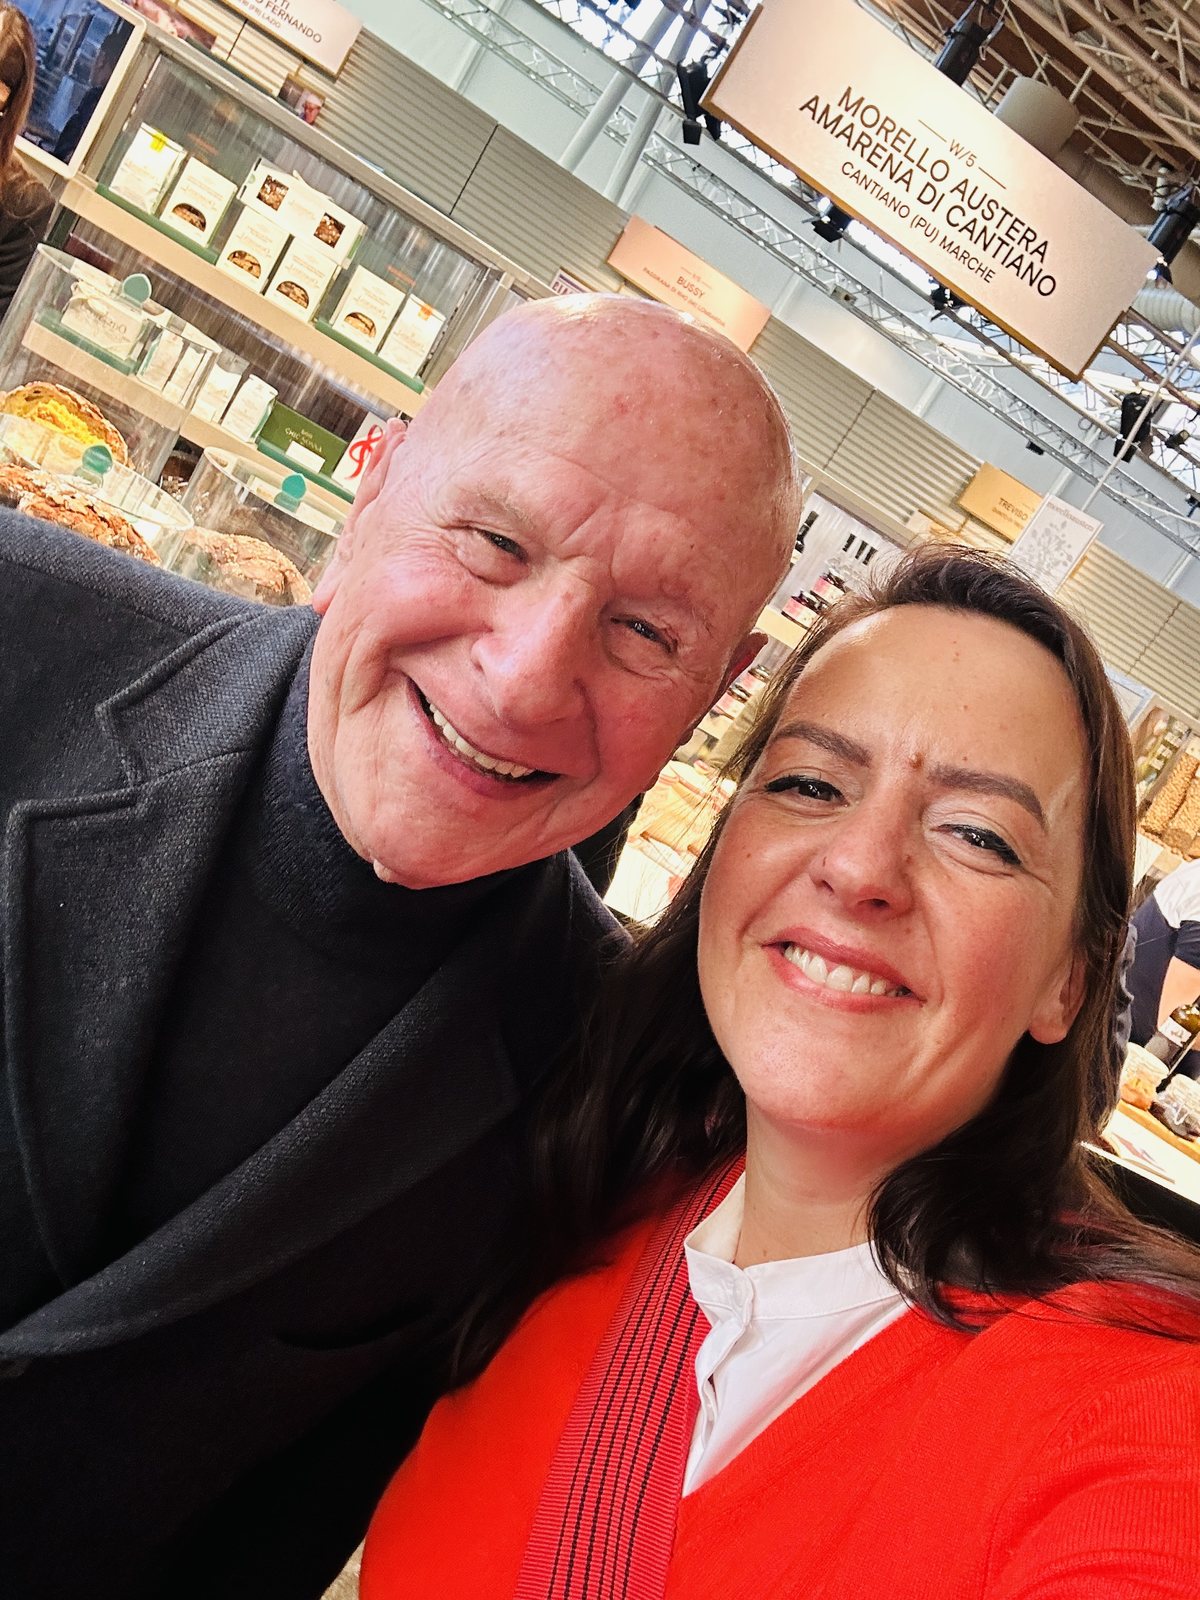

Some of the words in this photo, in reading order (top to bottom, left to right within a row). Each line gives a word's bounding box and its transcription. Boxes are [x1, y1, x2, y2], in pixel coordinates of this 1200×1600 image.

[265, 1, 322, 43] FERNANDO
[948, 139, 978, 168] W/5
[799, 95, 914, 192] AMARENA
[917, 181, 945, 213] DI
[946, 204, 1057, 297] CANTIANO
[837, 86, 950, 182] MORELLO
[950, 178, 1049, 264] AUSTERA
[841, 161, 910, 219] CANTIANO
[910, 215, 940, 244] (PU)
[938, 234, 996, 284] MARCHE
[676, 275, 706, 299] BUSSY
[999, 497, 1028, 521] TREVISO
